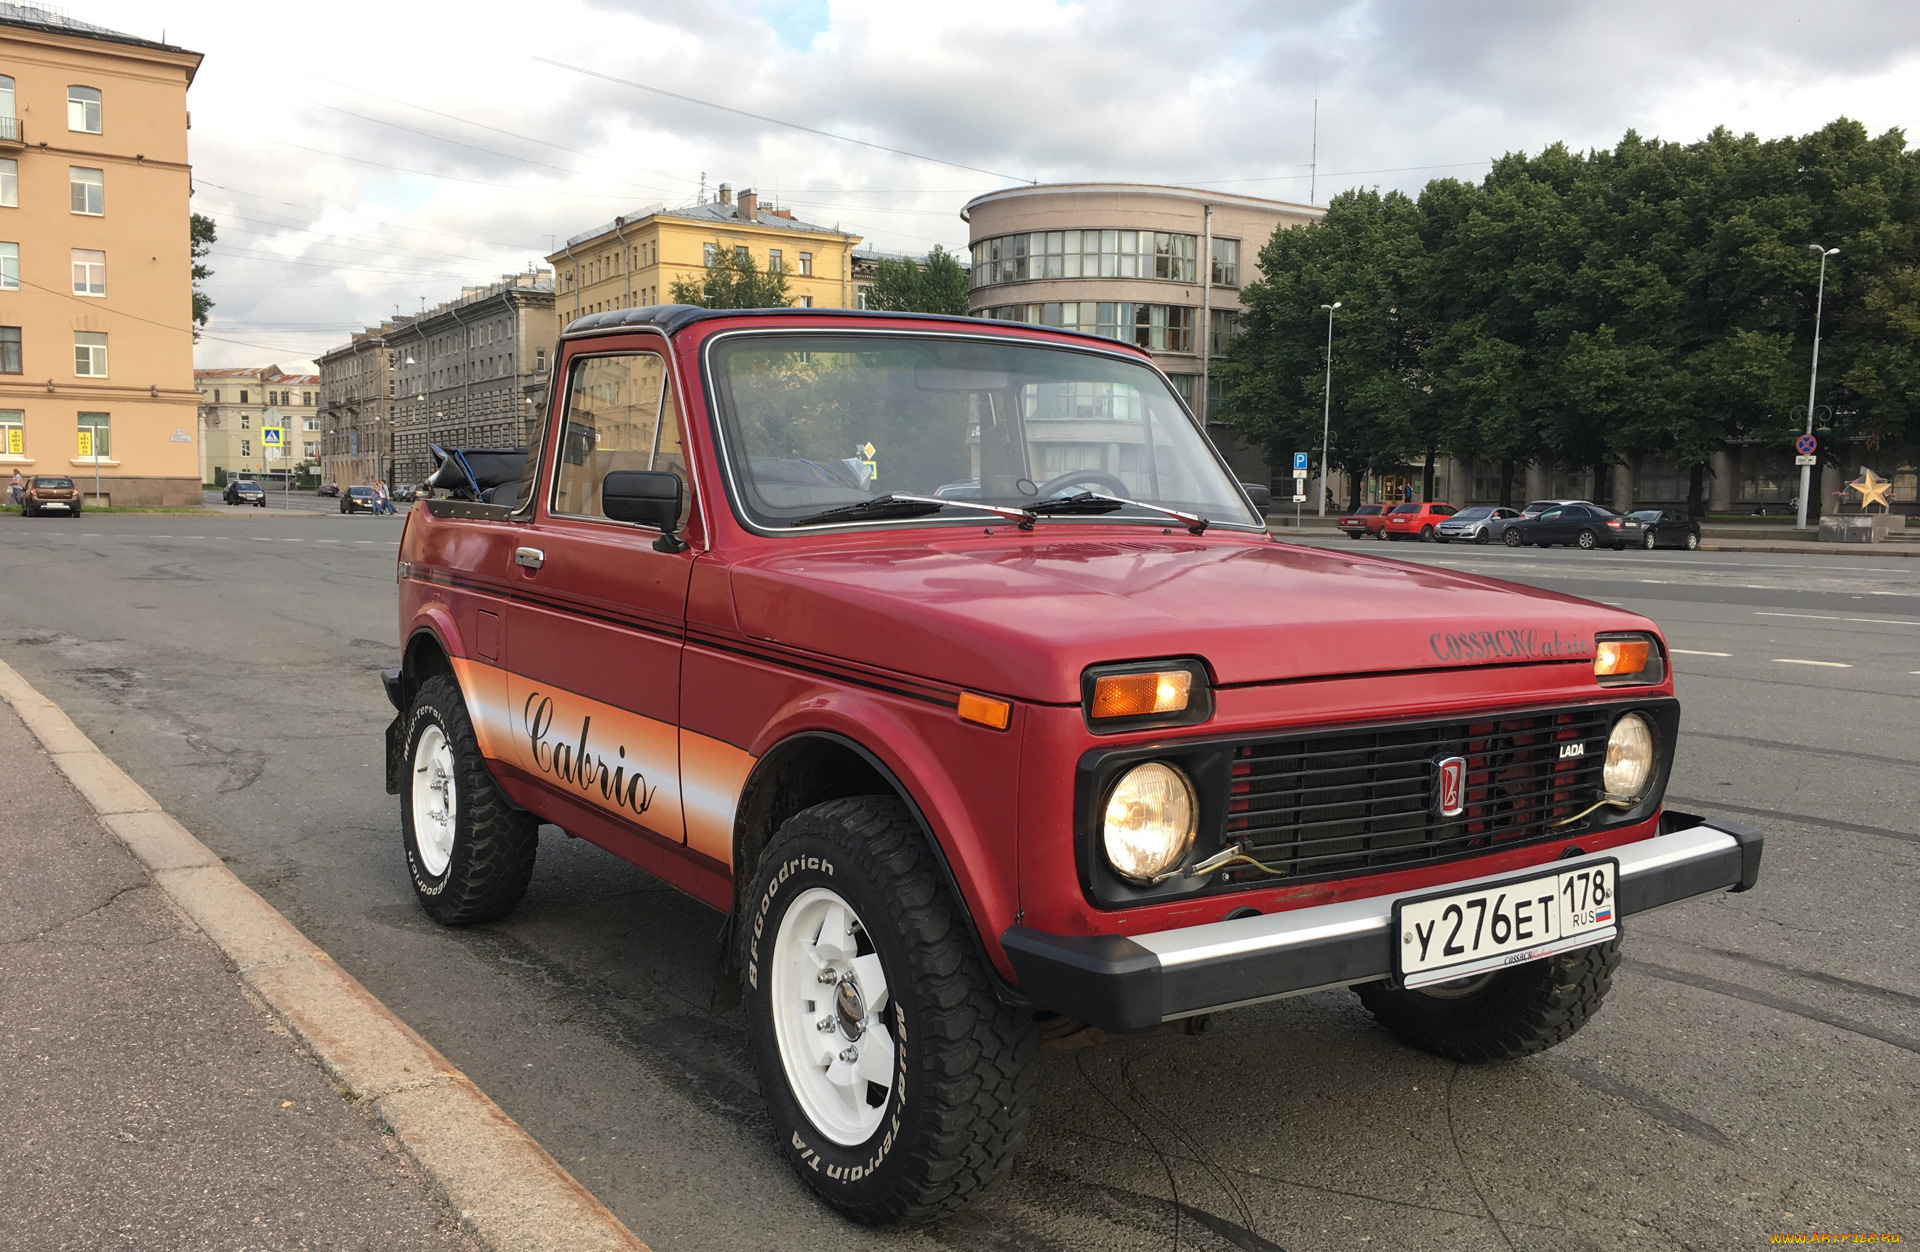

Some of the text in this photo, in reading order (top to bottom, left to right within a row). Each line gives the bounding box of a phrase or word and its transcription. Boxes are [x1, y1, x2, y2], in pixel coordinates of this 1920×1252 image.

[1296, 454, 1305, 467] P
[524, 691, 657, 815] Cabrio
[1559, 743, 1584, 758] LADA
[1562, 869, 1606, 914] 178
[749, 853, 835, 991] BFGoodrich
[1572, 910, 1595, 928] RUS
